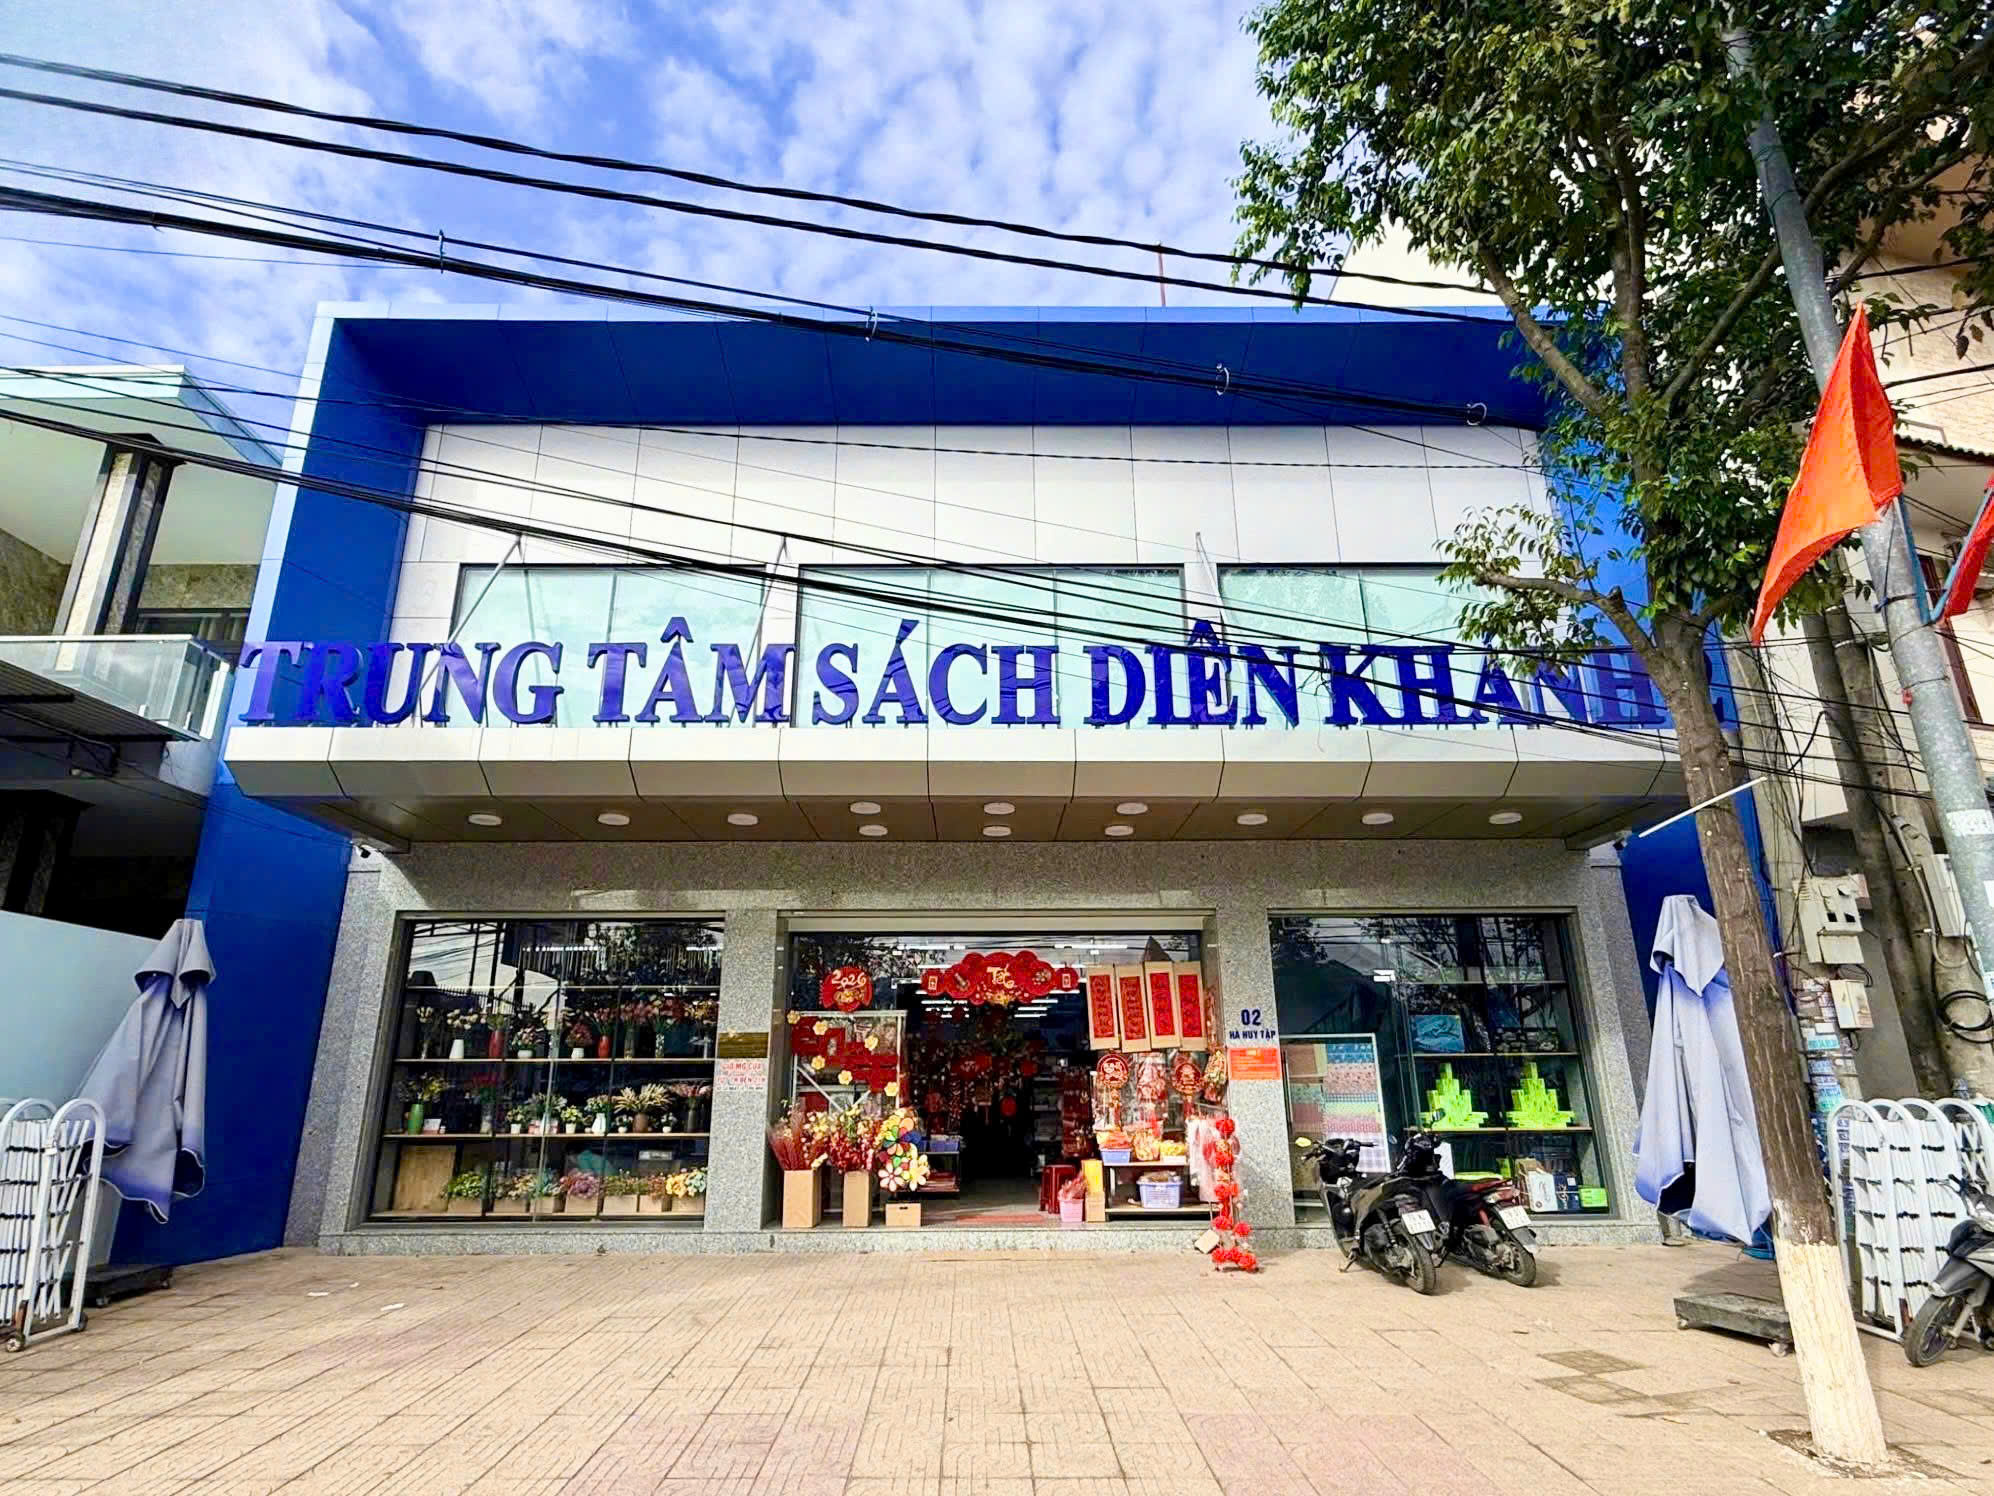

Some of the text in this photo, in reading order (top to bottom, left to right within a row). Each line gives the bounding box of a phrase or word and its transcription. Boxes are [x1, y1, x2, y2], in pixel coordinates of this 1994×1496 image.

[237, 640, 565, 726] TRUNG
[587, 616, 795, 725] TÂM
[811, 619, 1061, 725] SÁCH
[1083, 619, 1301, 726] DIÊN
[831, 969, 867, 986] 2026
[1241, 1009, 1261, 1026] 02
[1242, 1030, 1258, 1039] HUY
